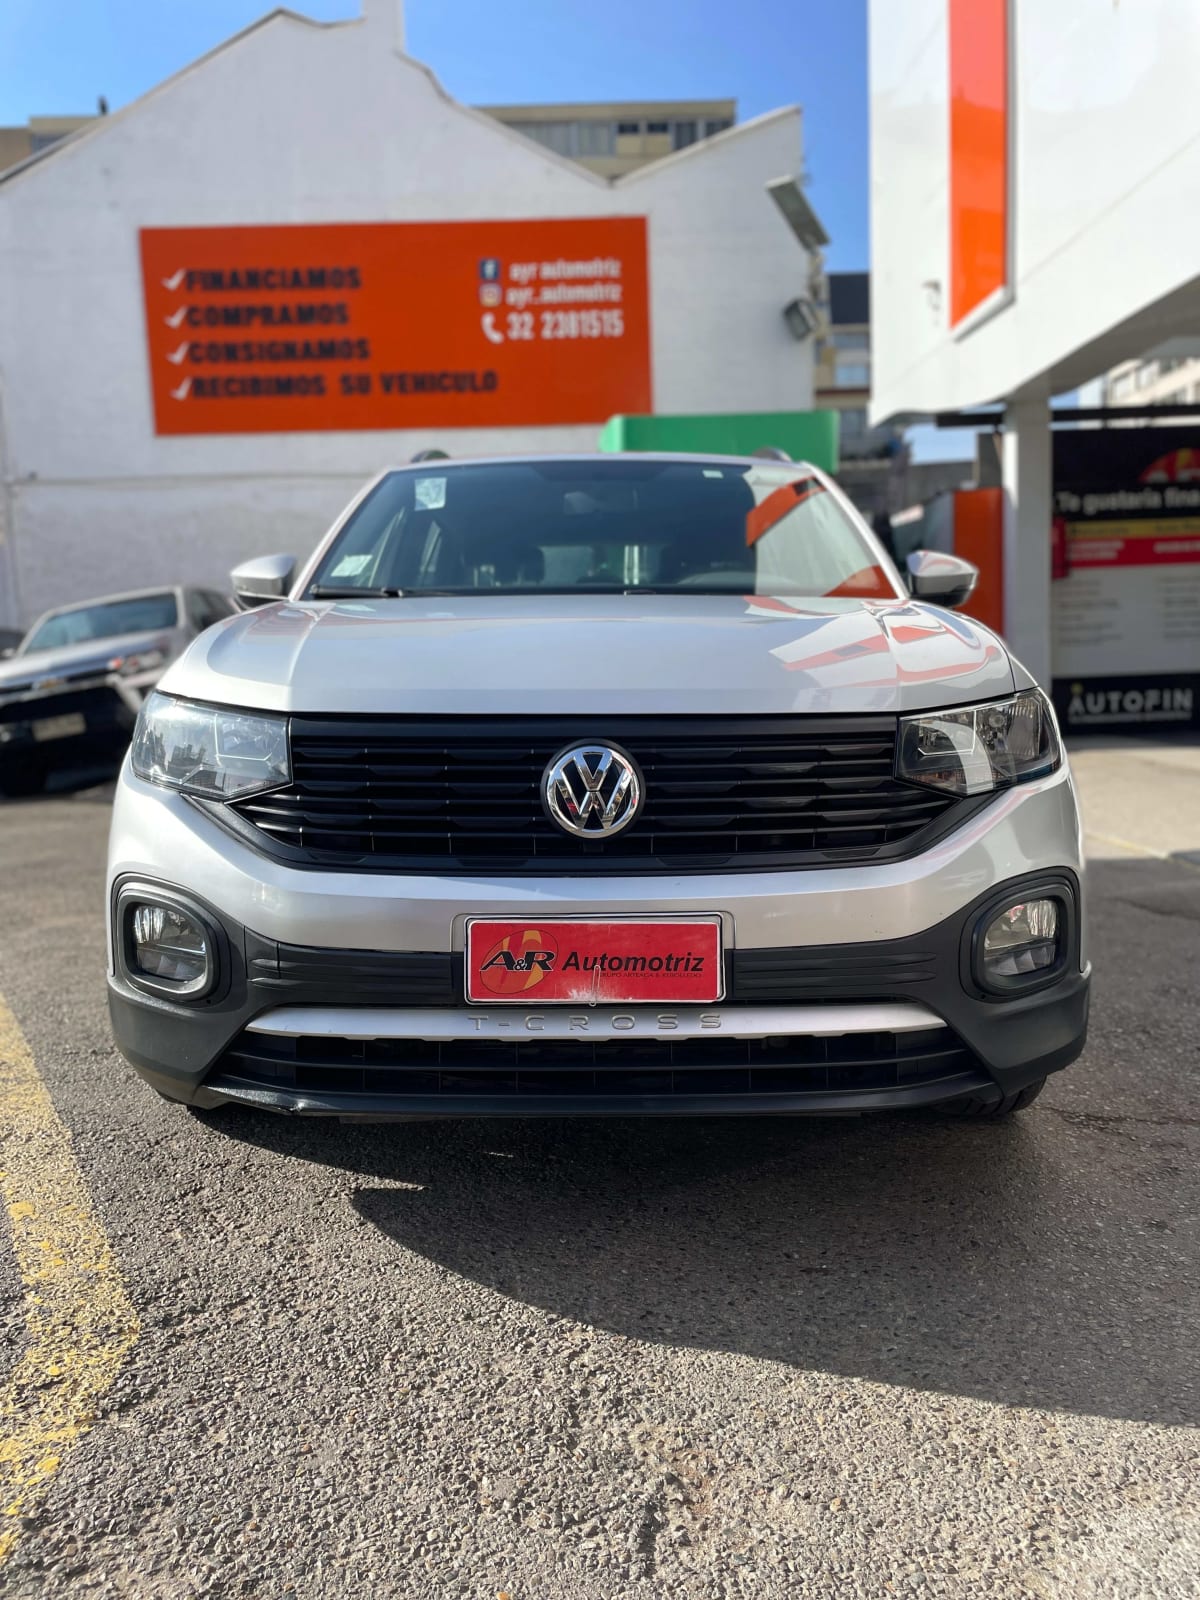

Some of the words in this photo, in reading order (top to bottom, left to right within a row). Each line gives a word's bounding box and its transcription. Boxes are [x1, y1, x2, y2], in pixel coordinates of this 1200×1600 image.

[186, 267, 361, 292] FINANCIAMOS
[541, 257, 621, 280] automotriz
[187, 303, 348, 327] COMPRAMOS
[507, 311, 534, 340] 32
[189, 338, 369, 364] CONSIGNAMOS
[193, 373, 325, 398] RECIBIMOS
[340, 372, 371, 396] SU
[380, 370, 498, 393] VEHICULO
[1068, 687, 1193, 717] AUTOFIN
[480, 950, 555, 972] A&R
[561, 951, 705, 972] Automotriz
[468, 1013, 722, 1031] T-CROSS
